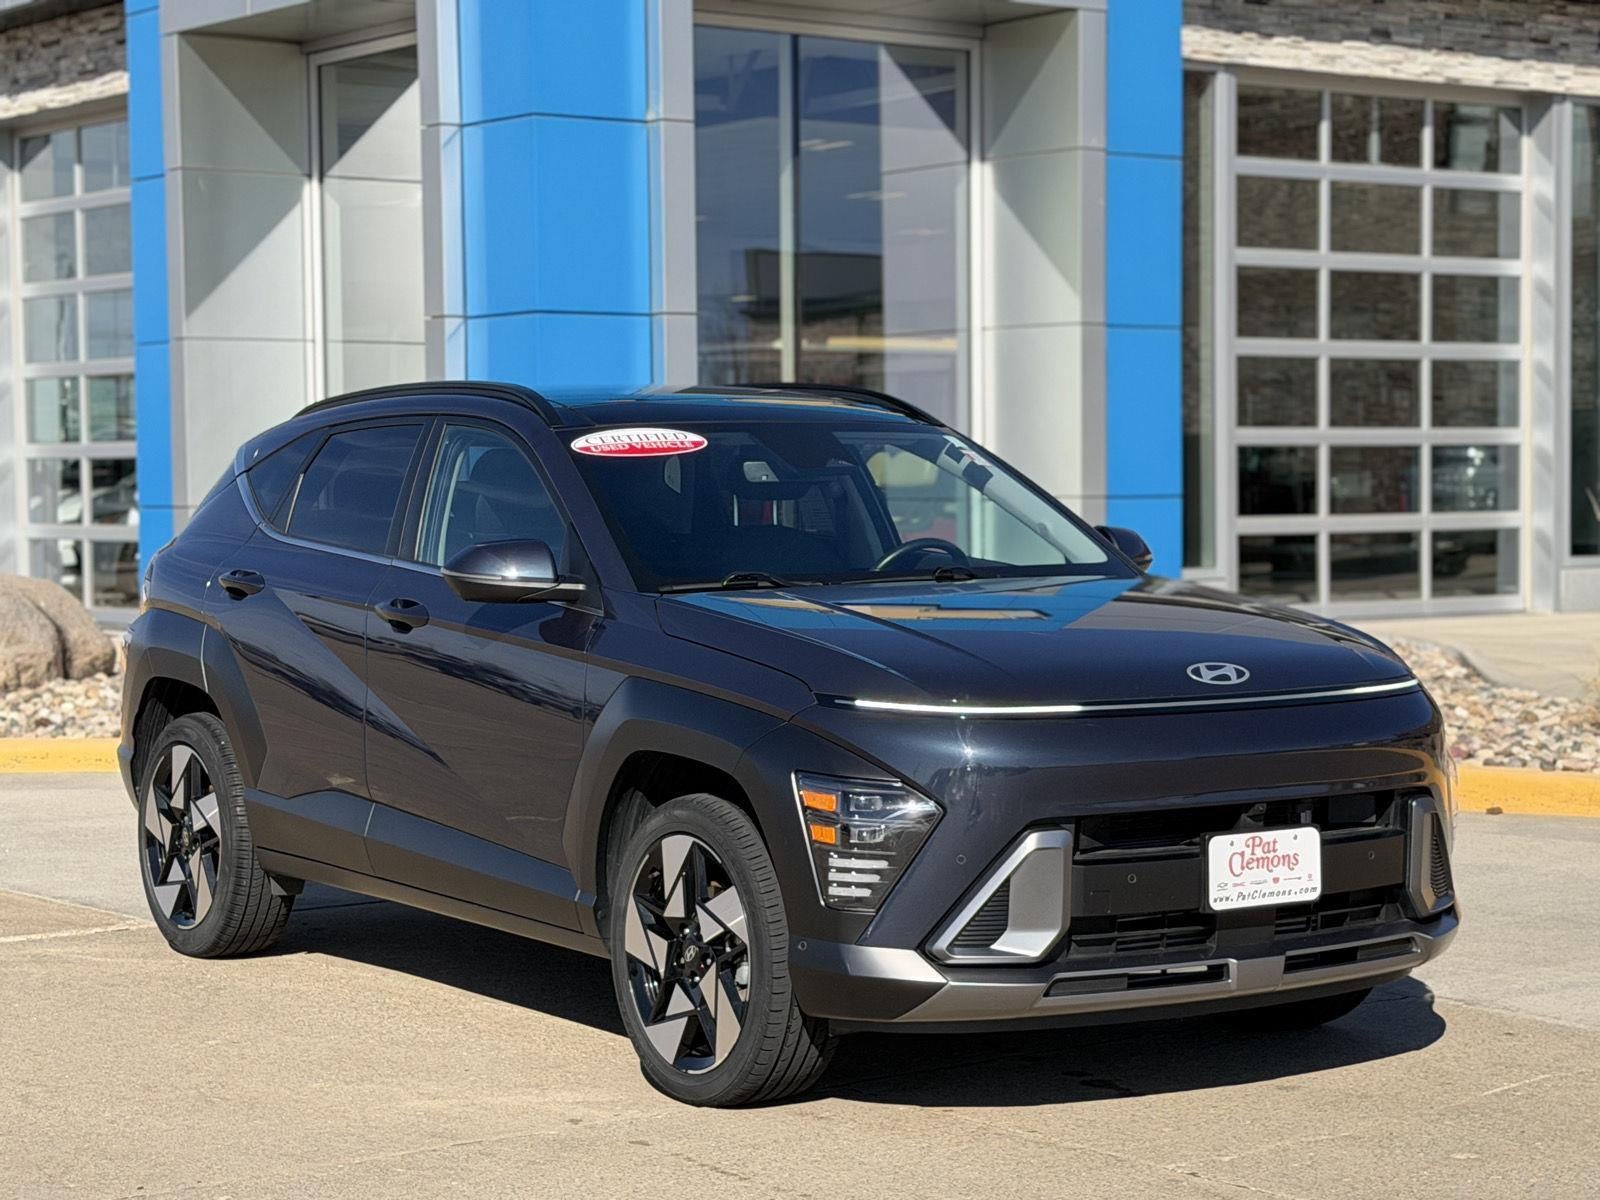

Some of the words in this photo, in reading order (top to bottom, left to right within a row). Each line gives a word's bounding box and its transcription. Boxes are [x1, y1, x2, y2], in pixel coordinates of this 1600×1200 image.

[584, 432, 689, 445] CERTIFIED
[590, 442, 631, 453] USED
[632, 440, 695, 450] VEHICLE
[1245, 835, 1279, 856] Pat
[1228, 850, 1300, 878] Clemons
[1213, 886, 1318, 904] www.PatClemons.com
